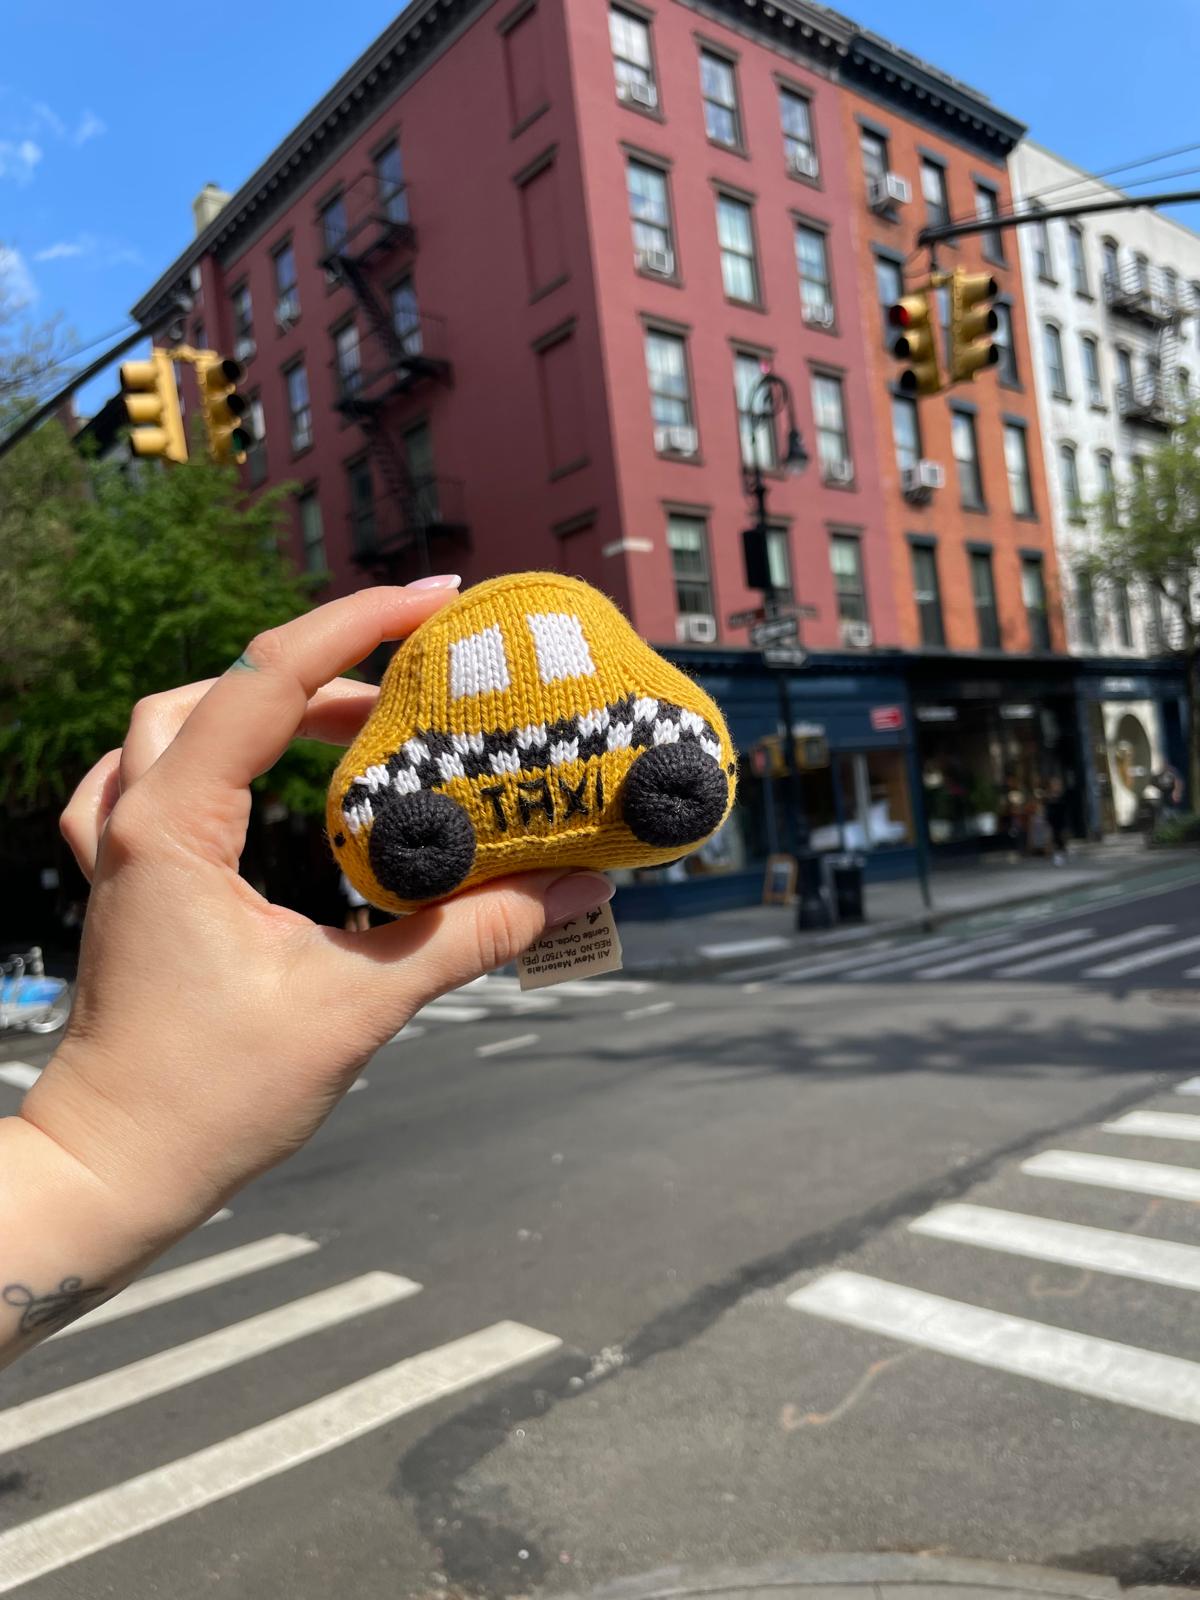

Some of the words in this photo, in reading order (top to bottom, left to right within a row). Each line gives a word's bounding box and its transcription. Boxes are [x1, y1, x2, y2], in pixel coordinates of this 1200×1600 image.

[480, 767, 604, 832] TAXI
[538, 940, 553, 949] Dry
[580, 938, 612, 953] REG.NO
[522, 954, 540, 966] (PE)
[541, 949, 576, 962] PA-17507
[573, 953, 596, 964] New
[598, 949, 610, 959] All
[527, 959, 572, 974] Materials
